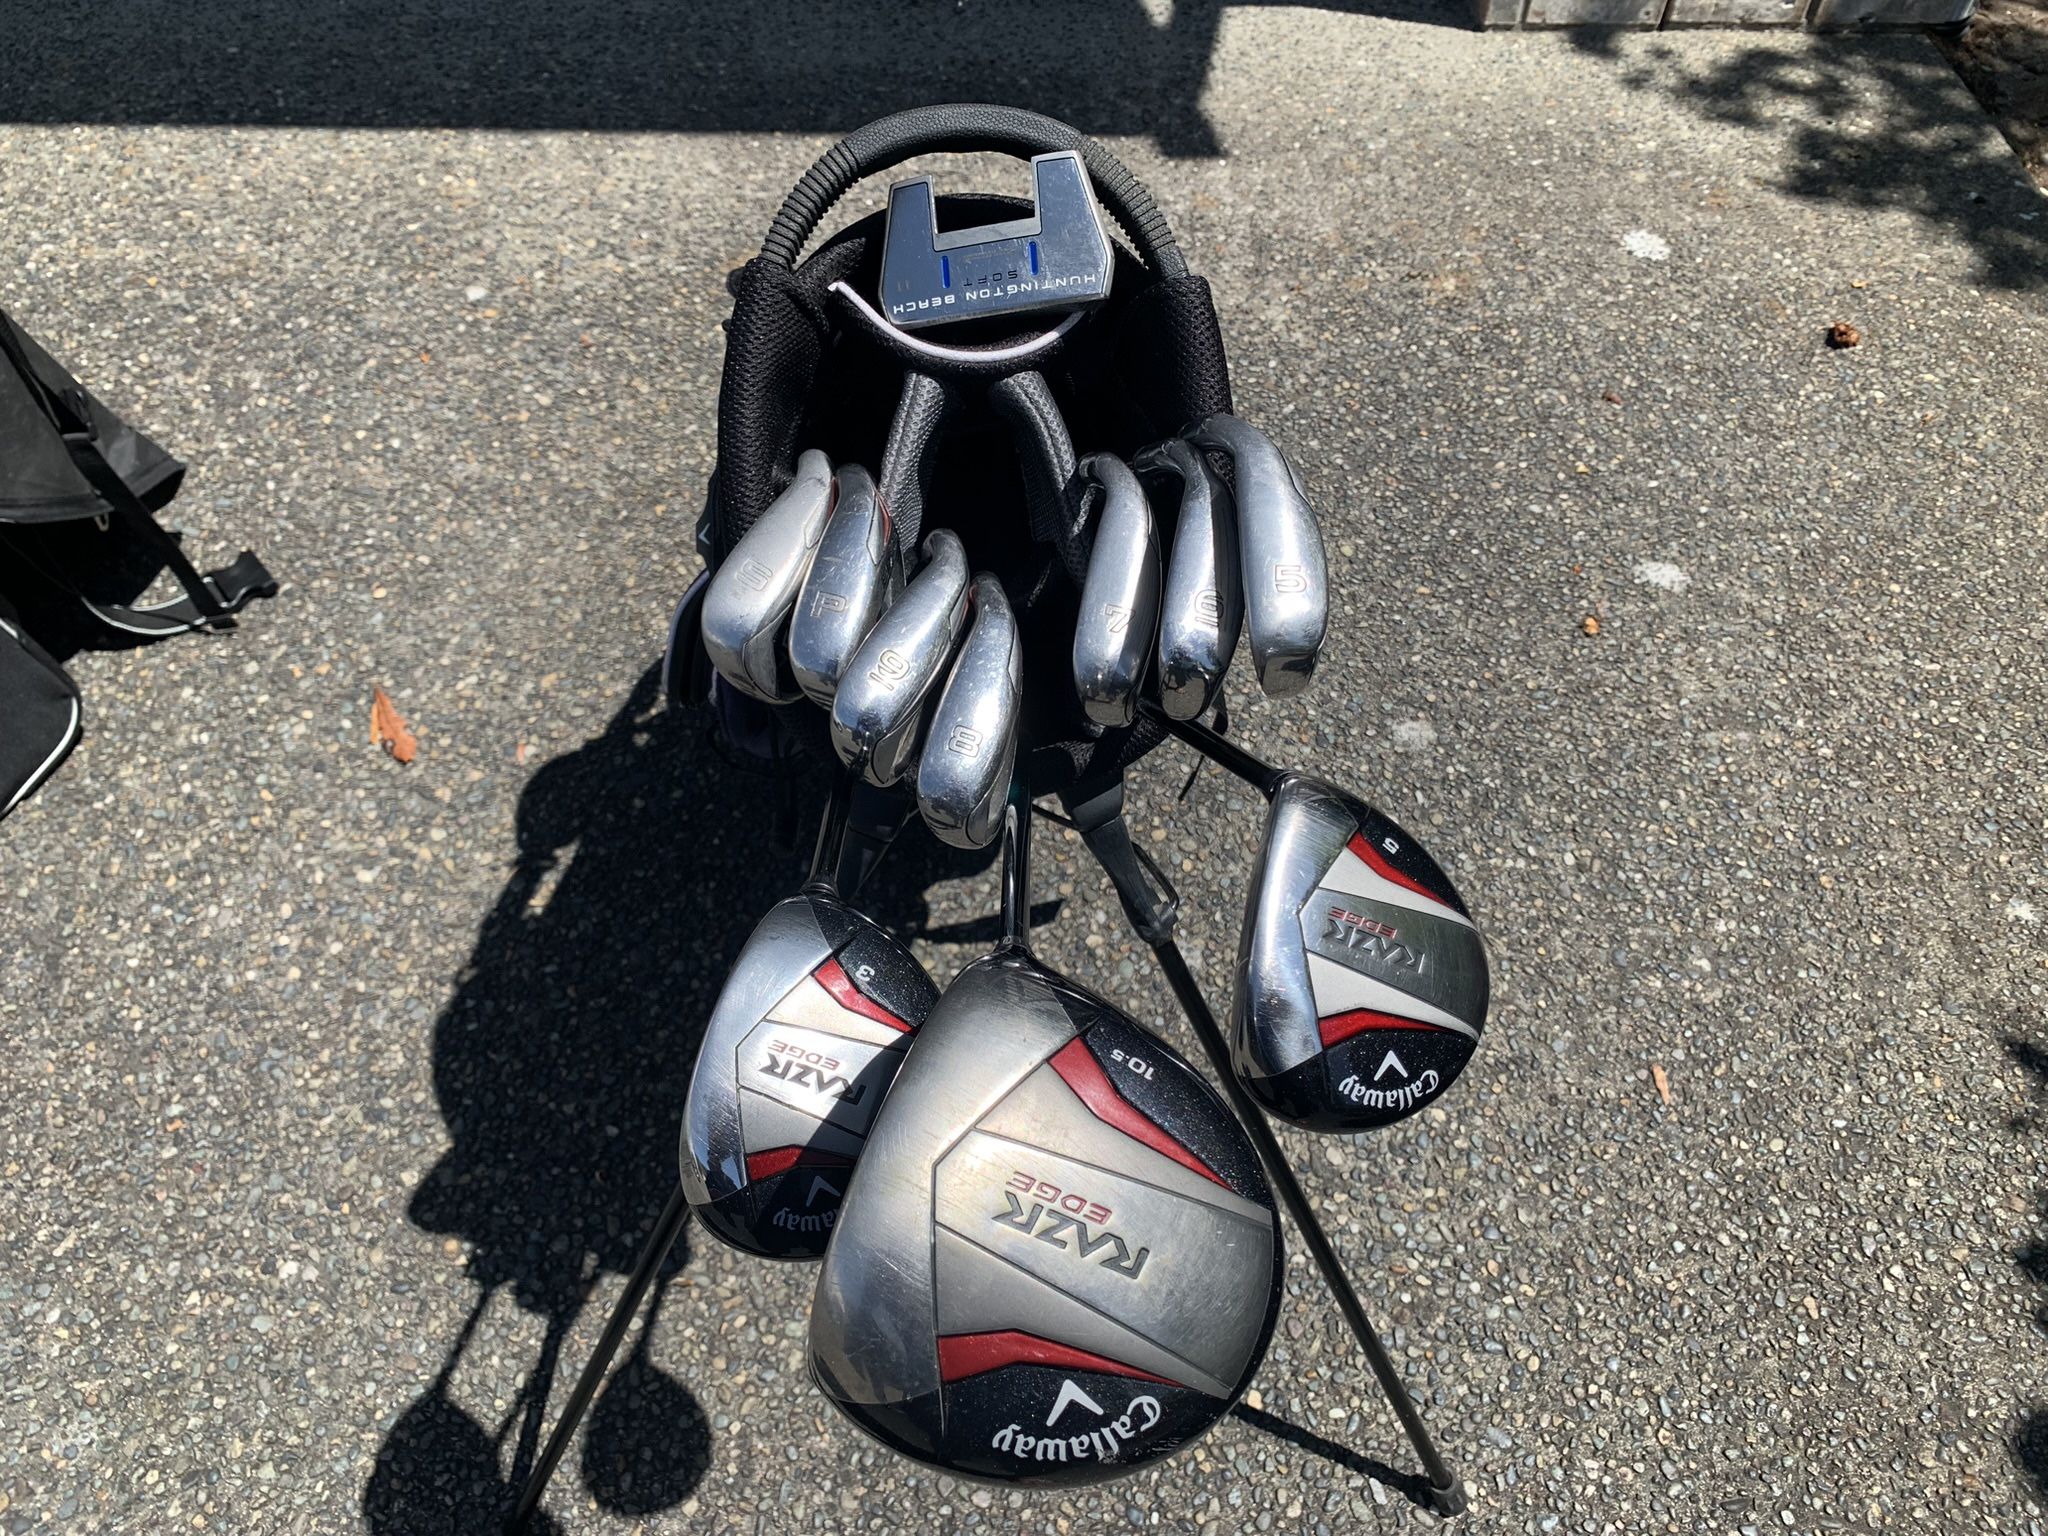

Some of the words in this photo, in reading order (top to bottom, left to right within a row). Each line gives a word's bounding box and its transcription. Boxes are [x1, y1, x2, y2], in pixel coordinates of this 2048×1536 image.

[963, 269, 1018, 287] SOFT
[966, 273, 1097, 302] HUNTINGTON
[893, 294, 955, 315] BEACH
[1275, 565, 1307, 593] 5
[809, 590, 848, 620] P
[1104, 604, 1136, 633] 7
[948, 724, 985, 758] 8
[1382, 837, 1399, 854] 5
[1328, 906, 1397, 939] EDGE
[1321, 918, 1426, 974] RAZR
[855, 965, 875, 981] 3
[768, 1039, 840, 1071] EDGE
[1110, 1048, 1155, 1080] 10.5
[758, 1051, 866, 1105] RAZR
[1339, 1069, 1439, 1111] Callaway
[1006, 1171, 1112, 1225] EDGE
[772, 1206, 837, 1232] away
[991, 1191, 1150, 1280] RAZR
[992, 1395, 1161, 1465] Callaway
